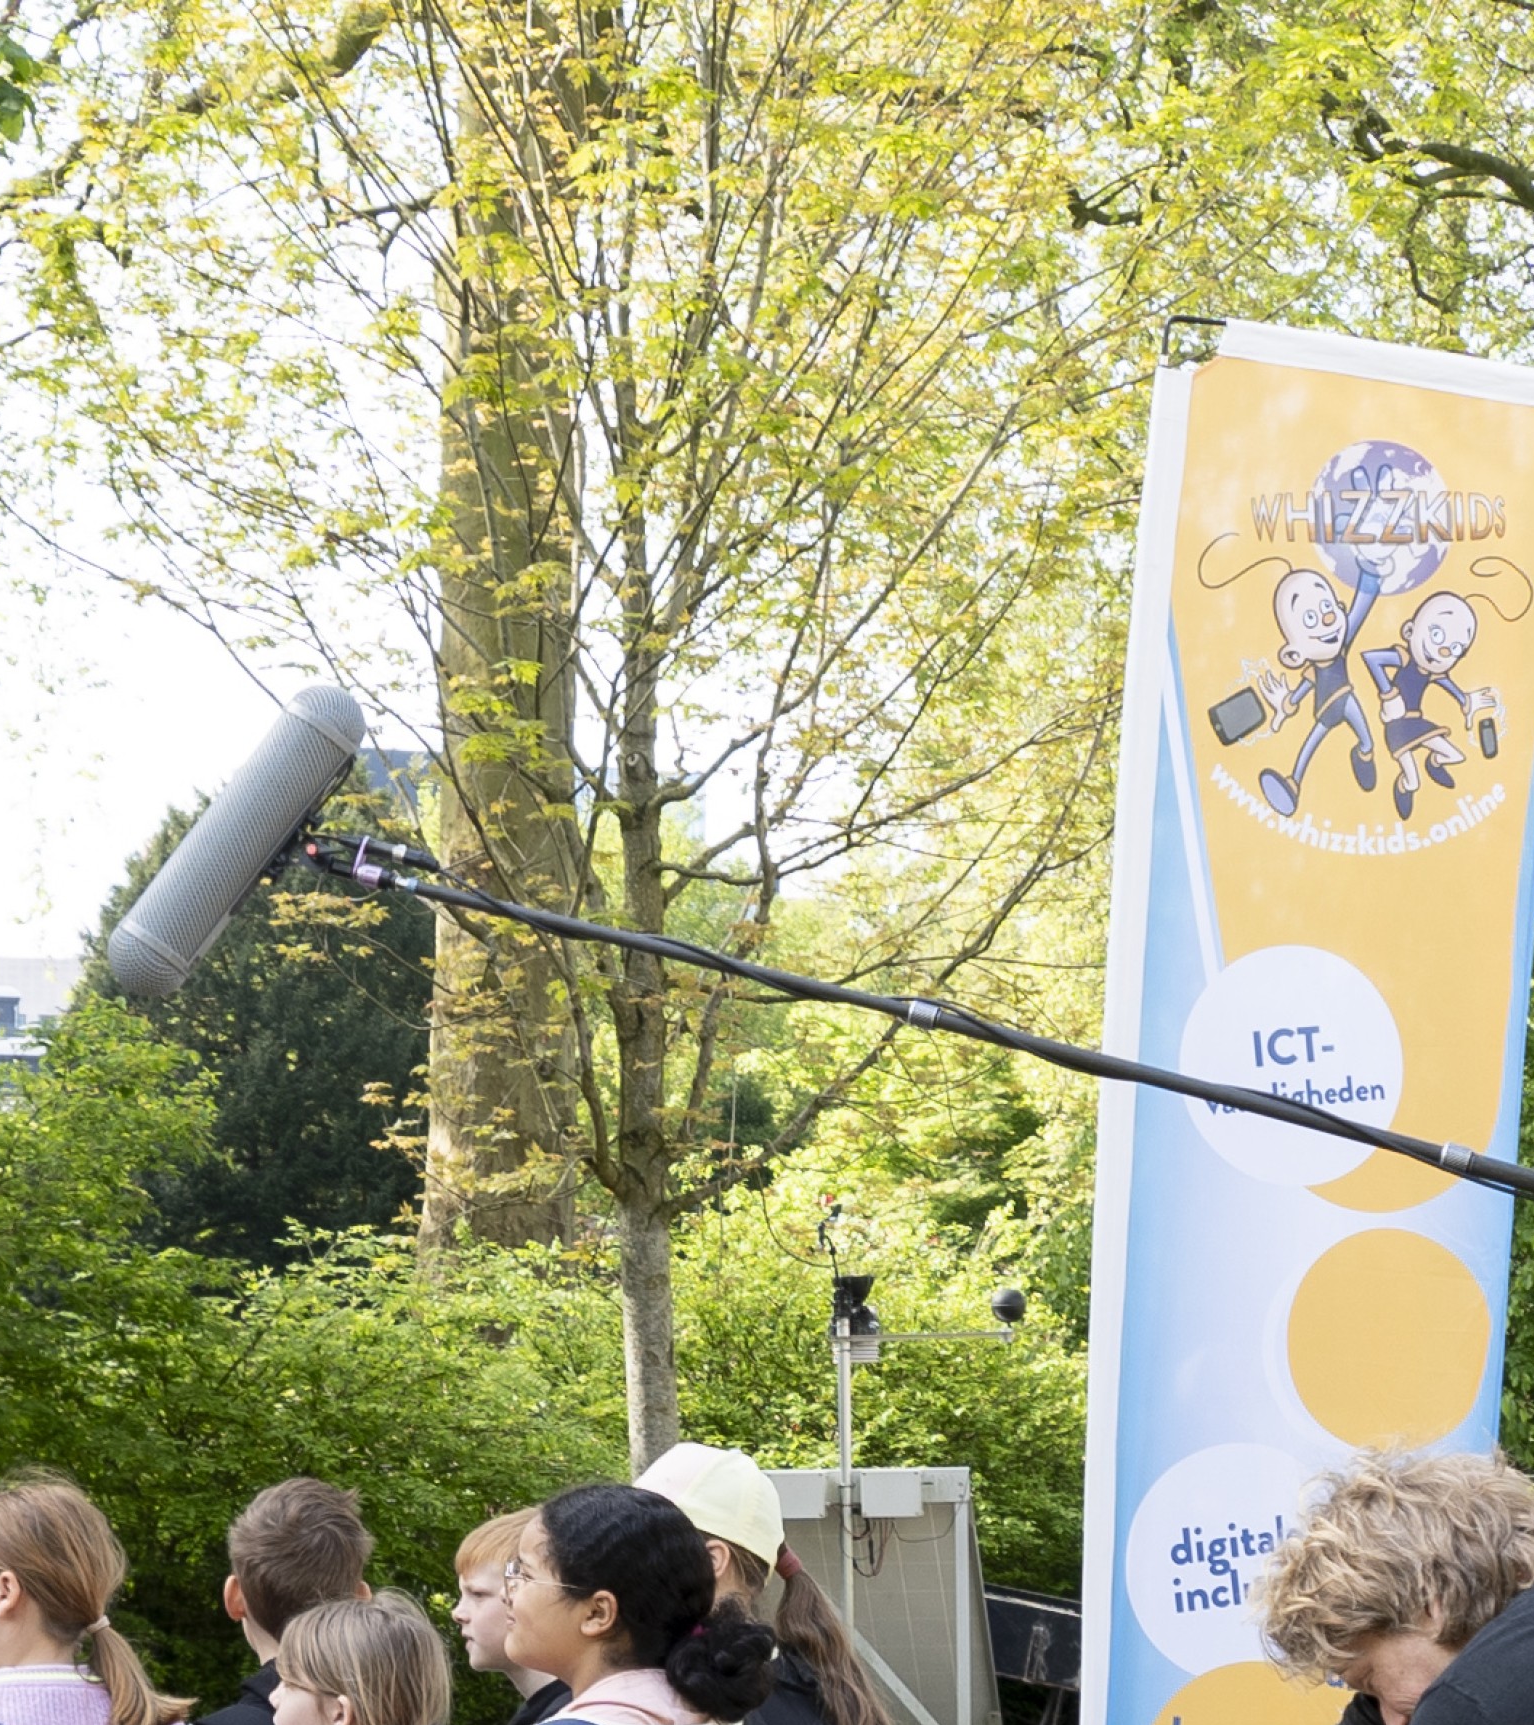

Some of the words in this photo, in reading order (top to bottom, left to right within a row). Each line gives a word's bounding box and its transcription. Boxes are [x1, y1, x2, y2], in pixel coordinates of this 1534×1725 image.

[1251, 489, 1507, 543] WHIZZKIDS
[1209, 762, 1507, 856] www.whizzkids.online
[1252, 1025, 1335, 1067] ICT-
